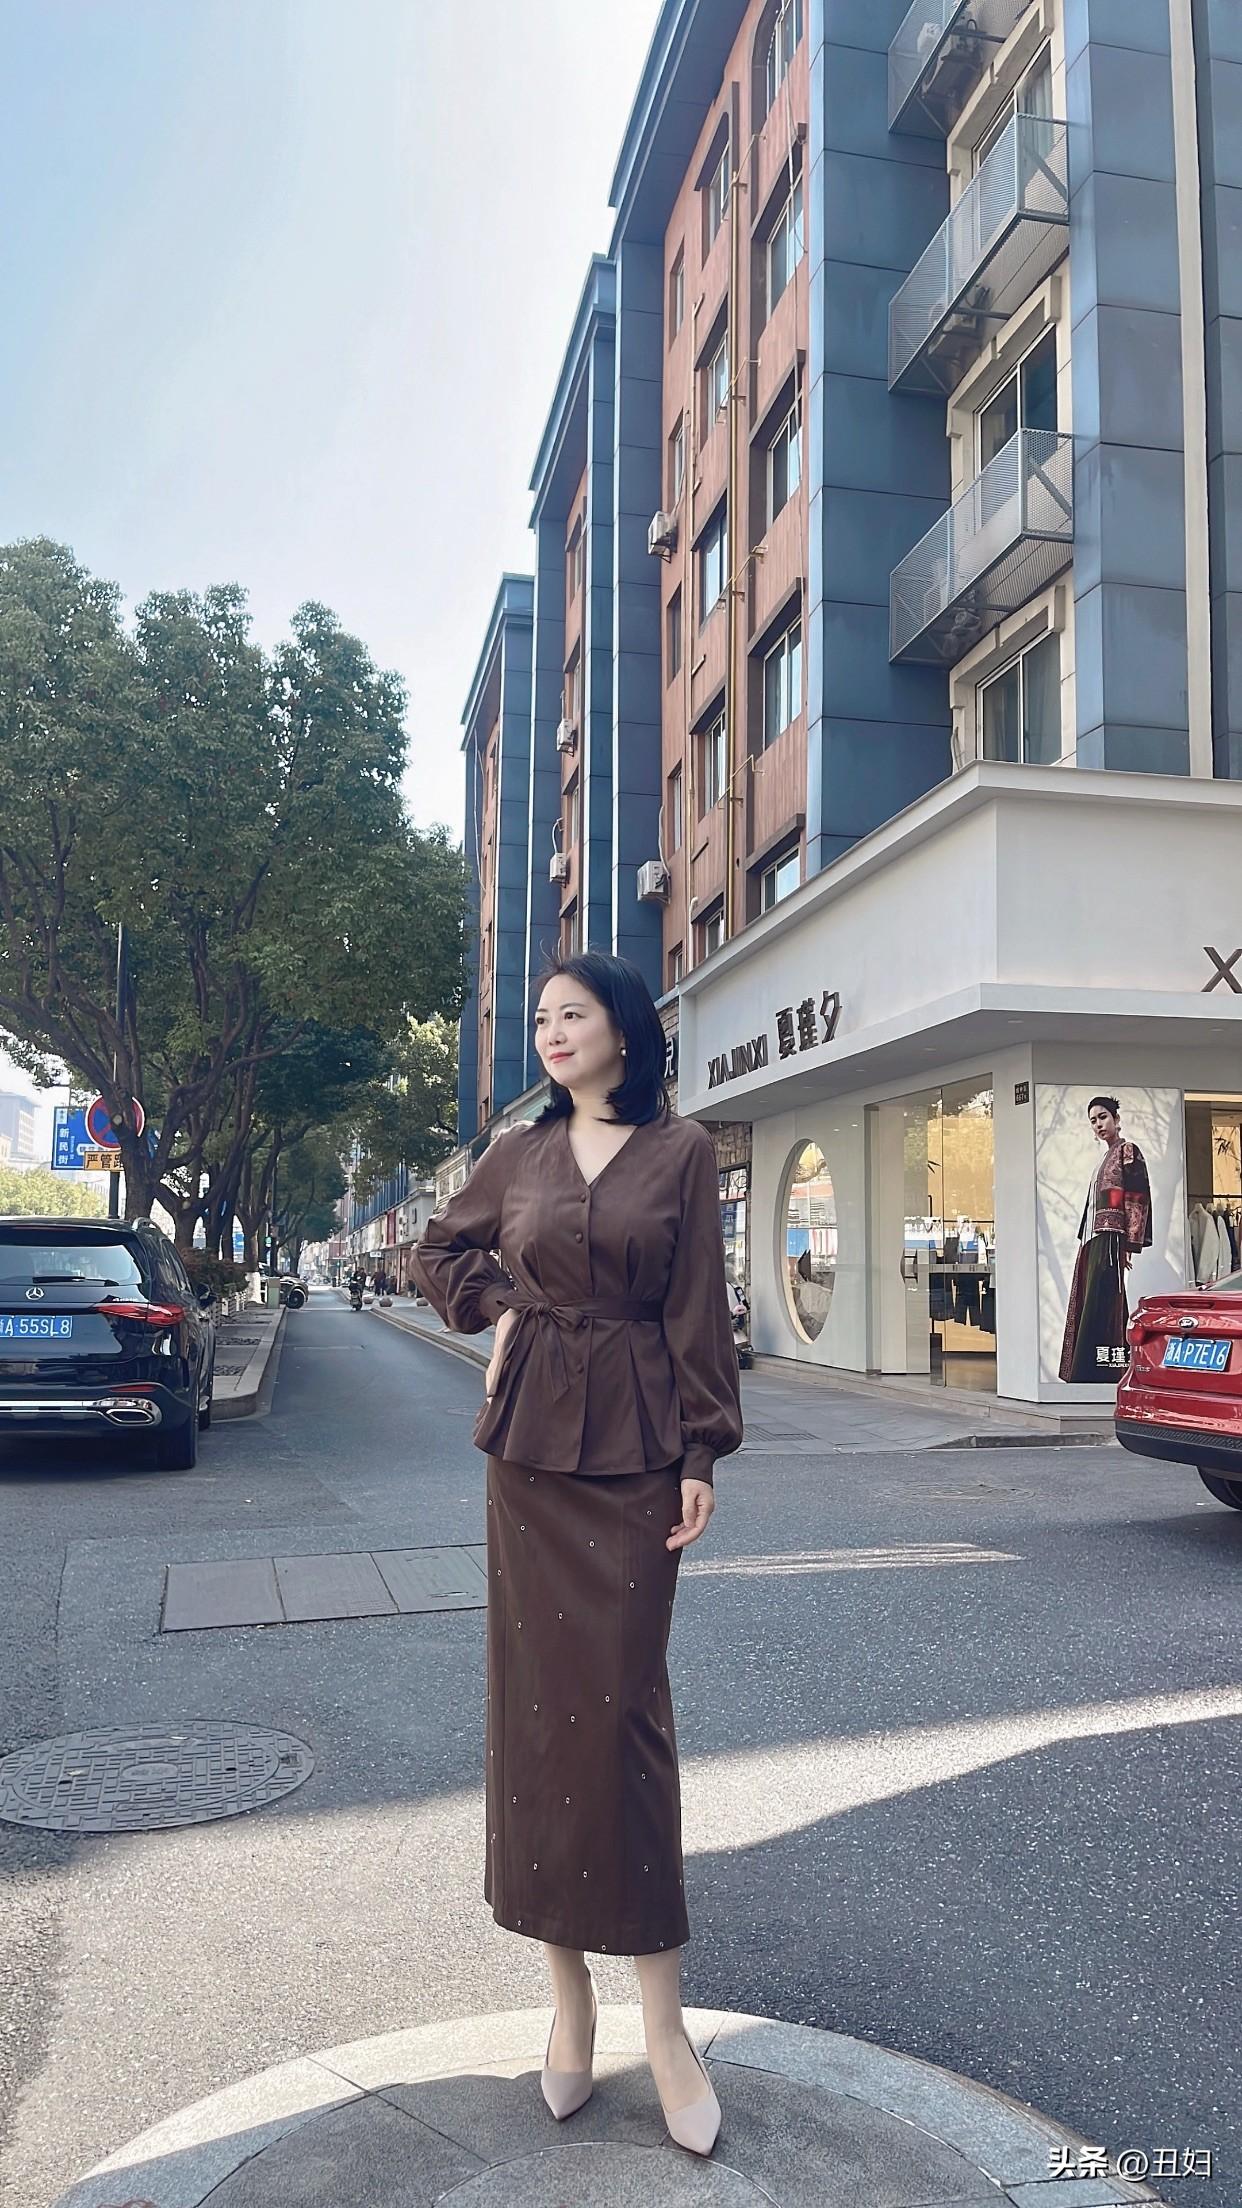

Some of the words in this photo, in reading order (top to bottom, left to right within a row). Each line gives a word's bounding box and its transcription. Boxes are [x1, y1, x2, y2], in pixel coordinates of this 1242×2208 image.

[708, 1034, 768, 1089] XIAJINXI
[776, 991, 842, 1060] 夏瑾夕
[58, 1128, 70, 1165] 新民街
[1096, 1346, 1131, 1363] 夏瑾
